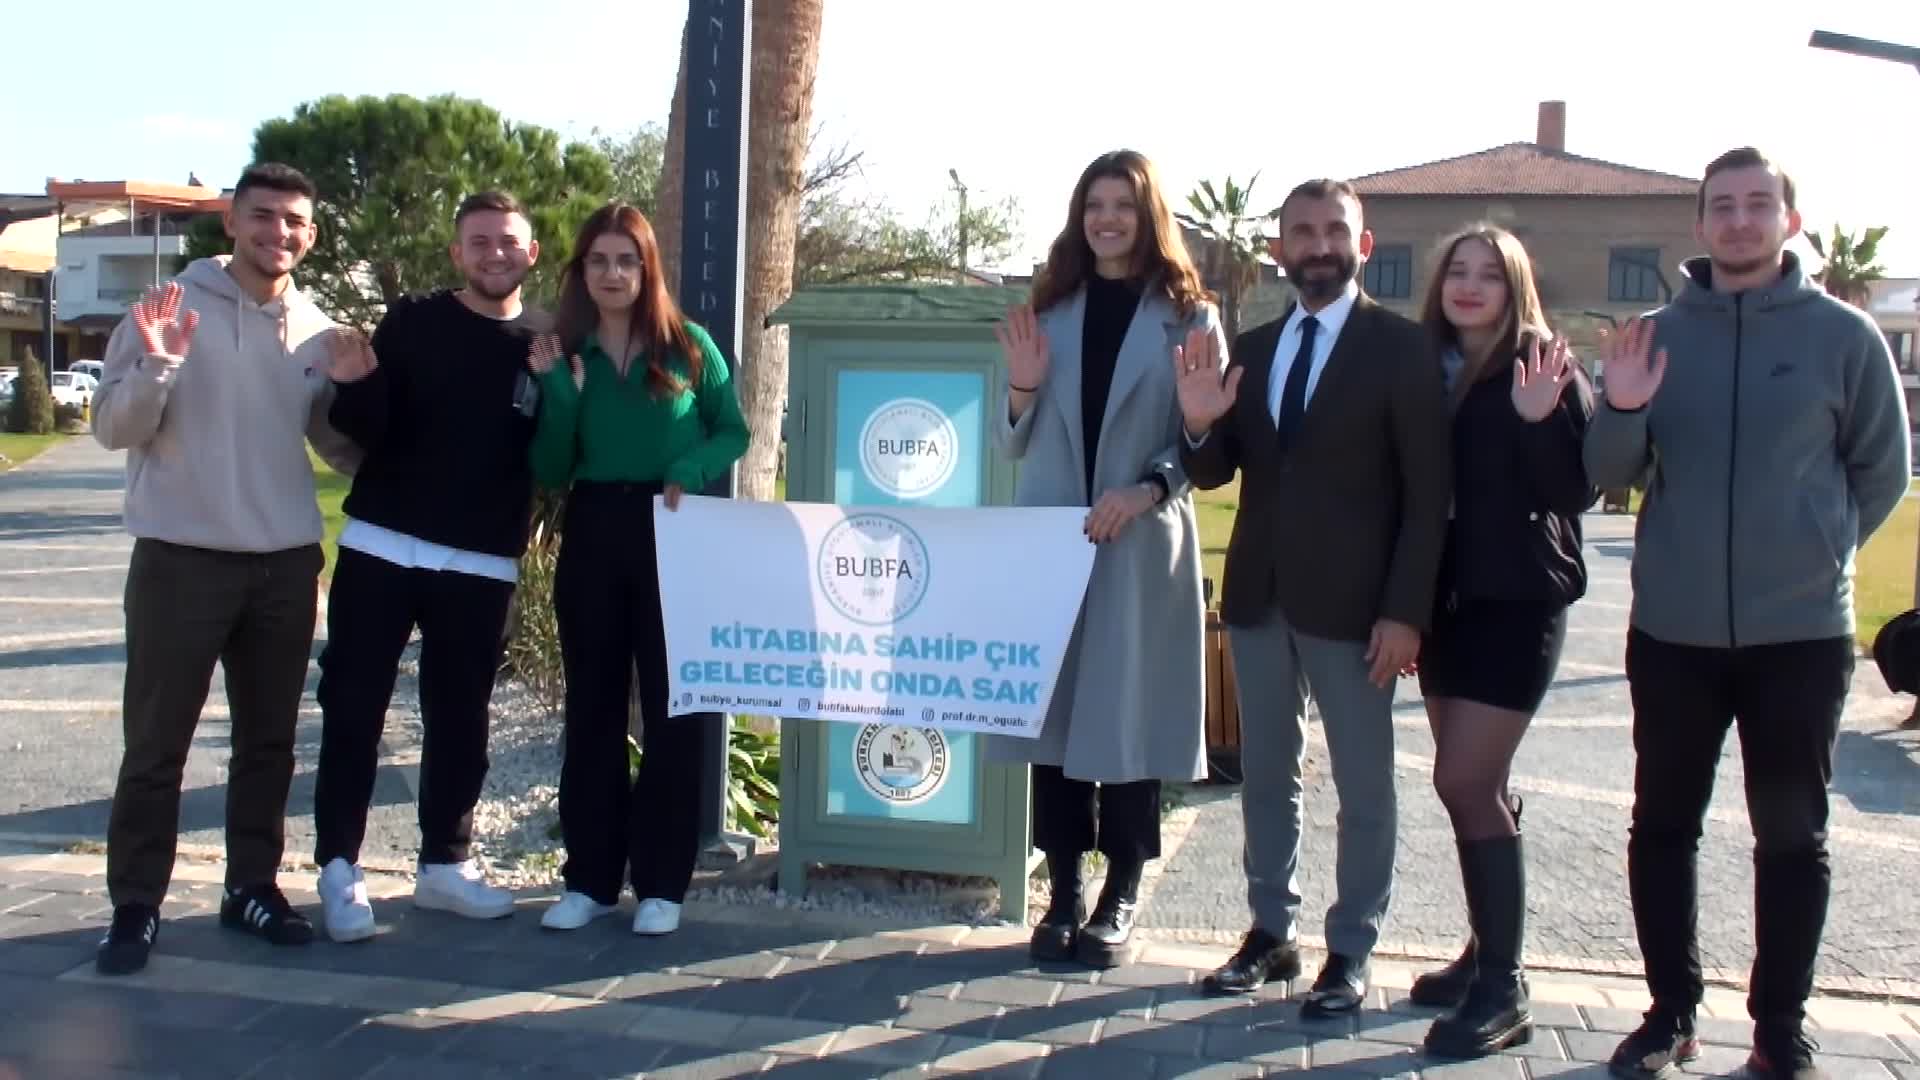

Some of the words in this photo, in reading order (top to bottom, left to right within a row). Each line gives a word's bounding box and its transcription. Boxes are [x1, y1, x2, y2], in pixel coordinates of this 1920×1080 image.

[702, 169, 719, 330] BELED
[878, 439, 939, 457] BUBFA
[835, 556, 913, 580] BUBFA
[710, 622, 867, 657] KİTABINA
[873, 630, 977, 665] SAHİP
[985, 642, 1041, 672] ÇIK
[679, 660, 863, 691] GELECEĞİN
[870, 671, 966, 700] ONDA
[972, 678, 1039, 705] SAK
